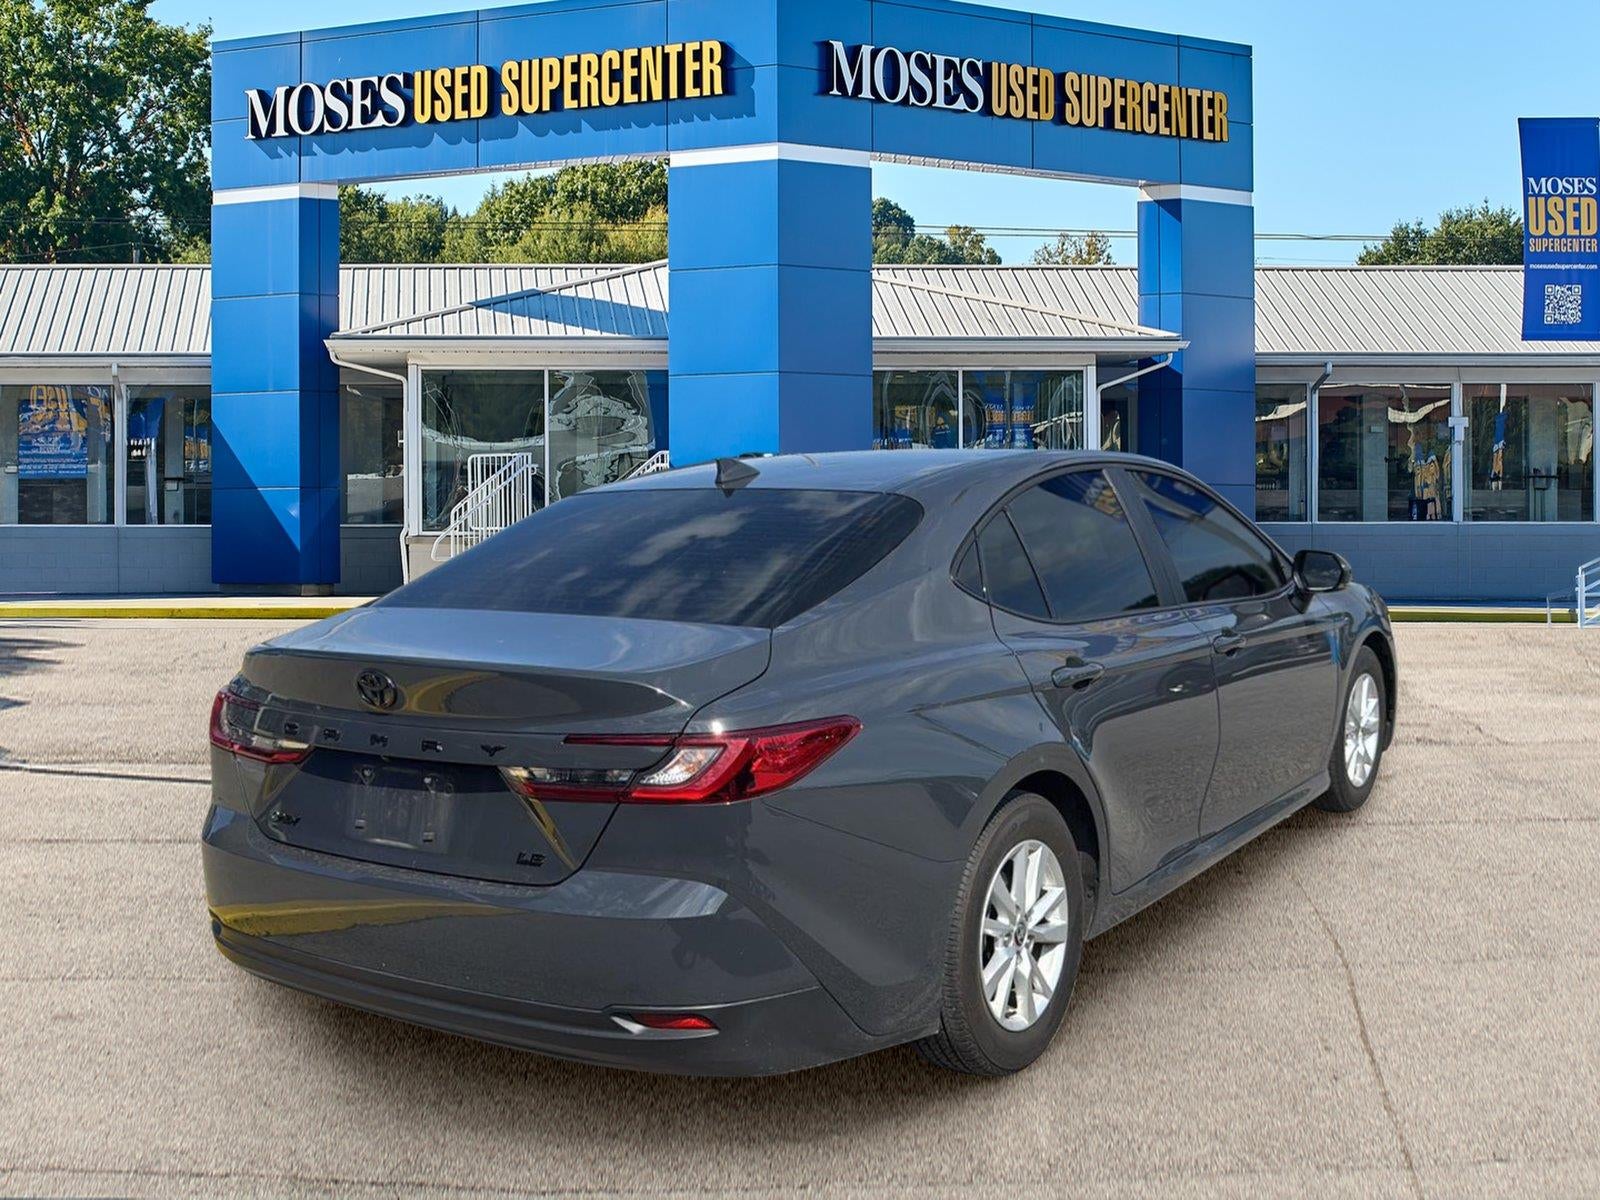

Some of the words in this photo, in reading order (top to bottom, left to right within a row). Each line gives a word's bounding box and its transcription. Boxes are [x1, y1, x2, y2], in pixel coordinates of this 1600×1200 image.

[244, 73, 407, 140] MOSES
[413, 64, 489, 125] USED
[500, 39, 724, 116] SUPERCENTER
[828, 39, 984, 113] MOSES
[990, 61, 1056, 122] USED
[1064, 71, 1231, 143] SUPERCENTER
[1527, 176, 1597, 195] MOSES
[1527, 196, 1598, 236] USED
[1529, 238, 1598, 253] SUPERCENTER
[1529, 263, 1598, 271] mosesusedsupercenter.com
